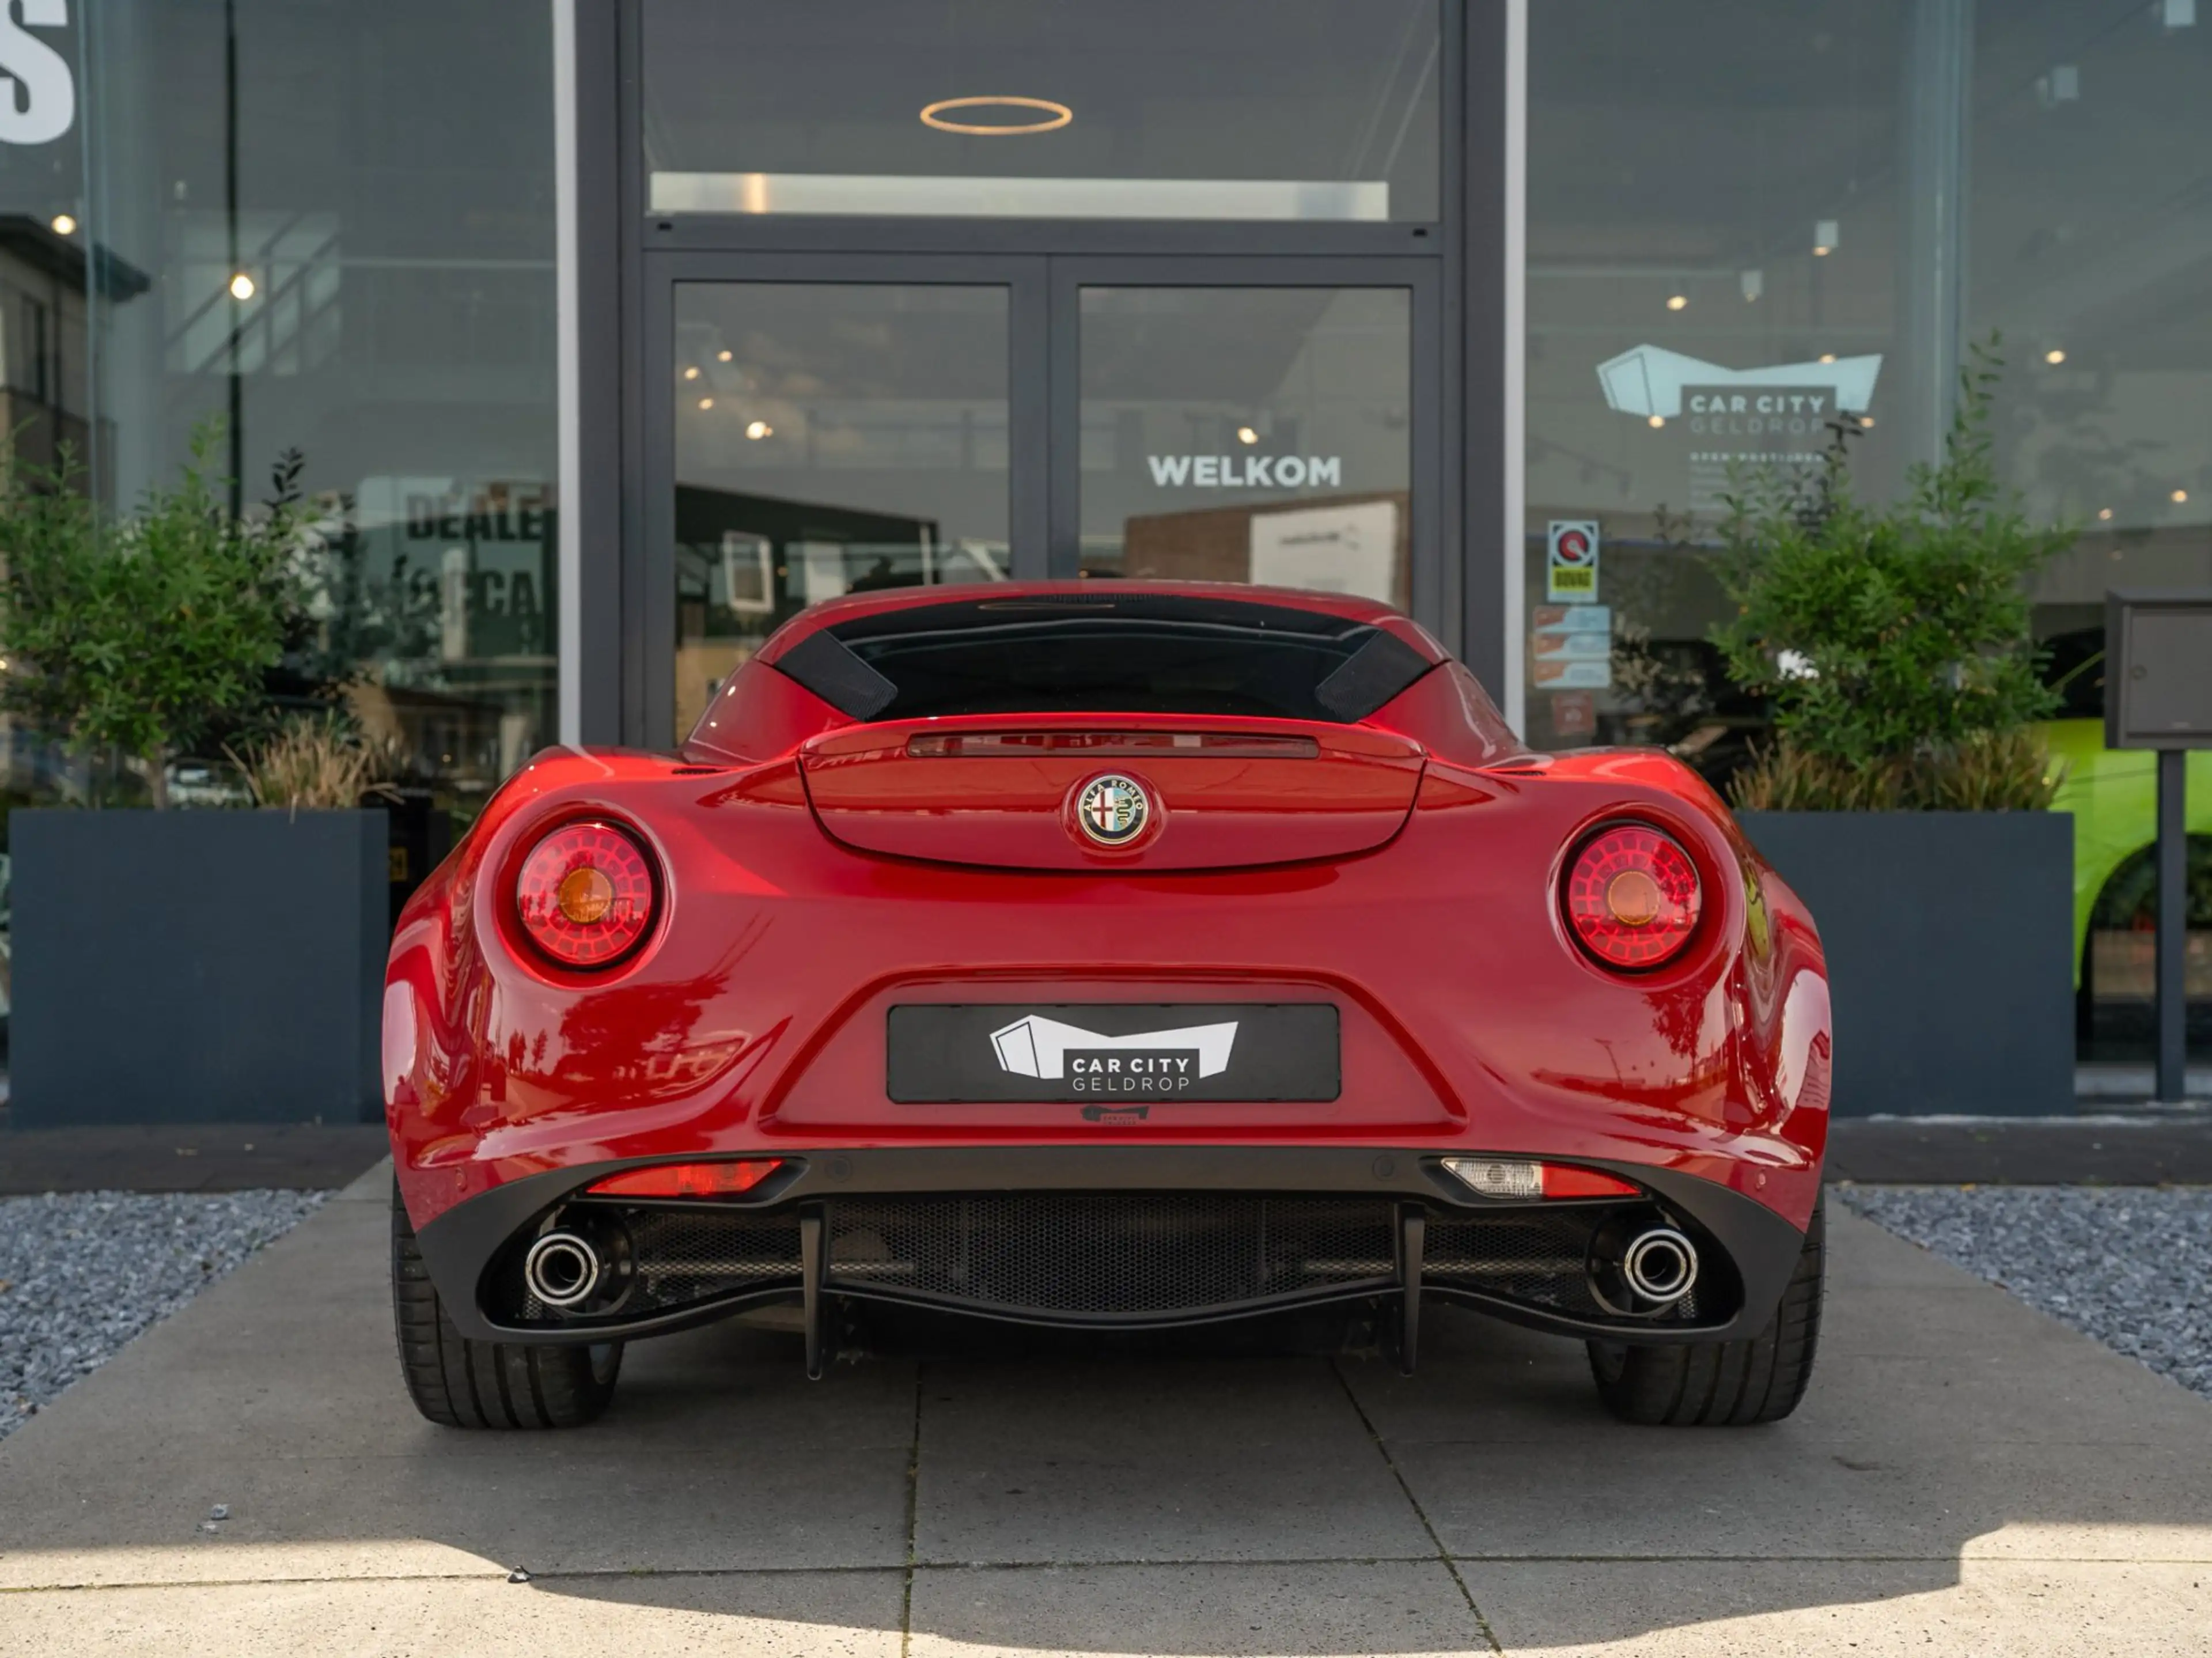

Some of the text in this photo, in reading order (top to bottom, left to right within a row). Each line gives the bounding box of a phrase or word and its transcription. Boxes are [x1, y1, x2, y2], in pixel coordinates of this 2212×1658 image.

[1690, 395, 1825, 414] CAR CITY
[1147, 455, 1341, 487] WELKOM
[1084, 780, 1143, 812] ALFA ROMEO
[1072, 1058, 1189, 1073] CAR CITY
[1073, 1077, 1189, 1091] GELDROP
